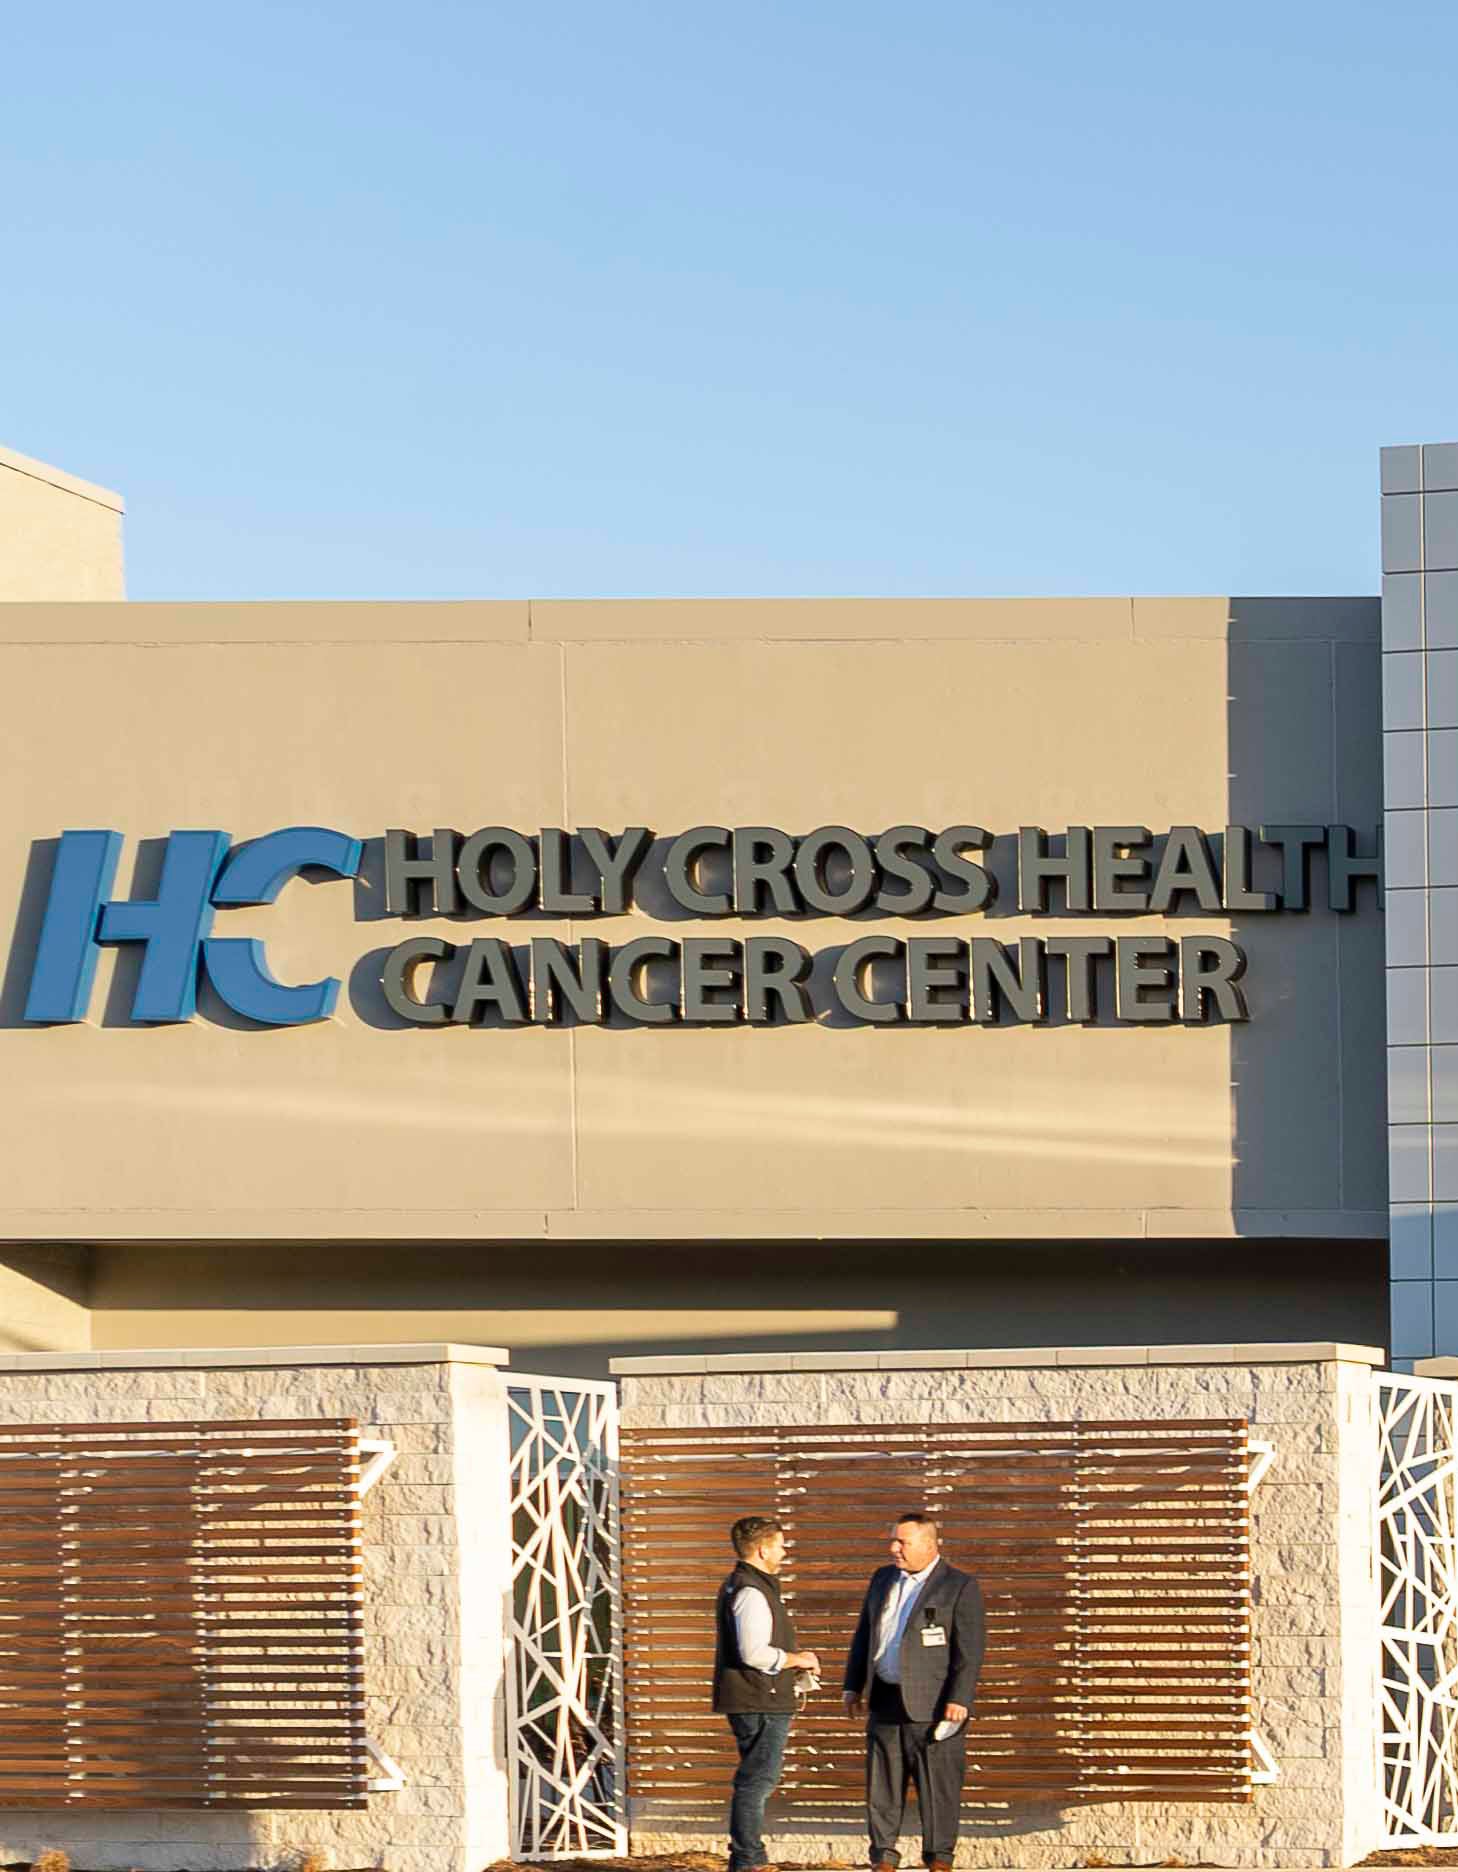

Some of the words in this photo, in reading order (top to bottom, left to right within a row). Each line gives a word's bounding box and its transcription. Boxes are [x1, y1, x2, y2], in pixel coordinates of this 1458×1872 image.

[384, 826, 656, 914] HOLY
[663, 825, 995, 915] CROSS
[1018, 825, 1384, 913] HEALTH
[24, 826, 365, 1025] HC
[382, 935, 820, 1023] CANCER
[833, 934, 1250, 1022] CENTER
